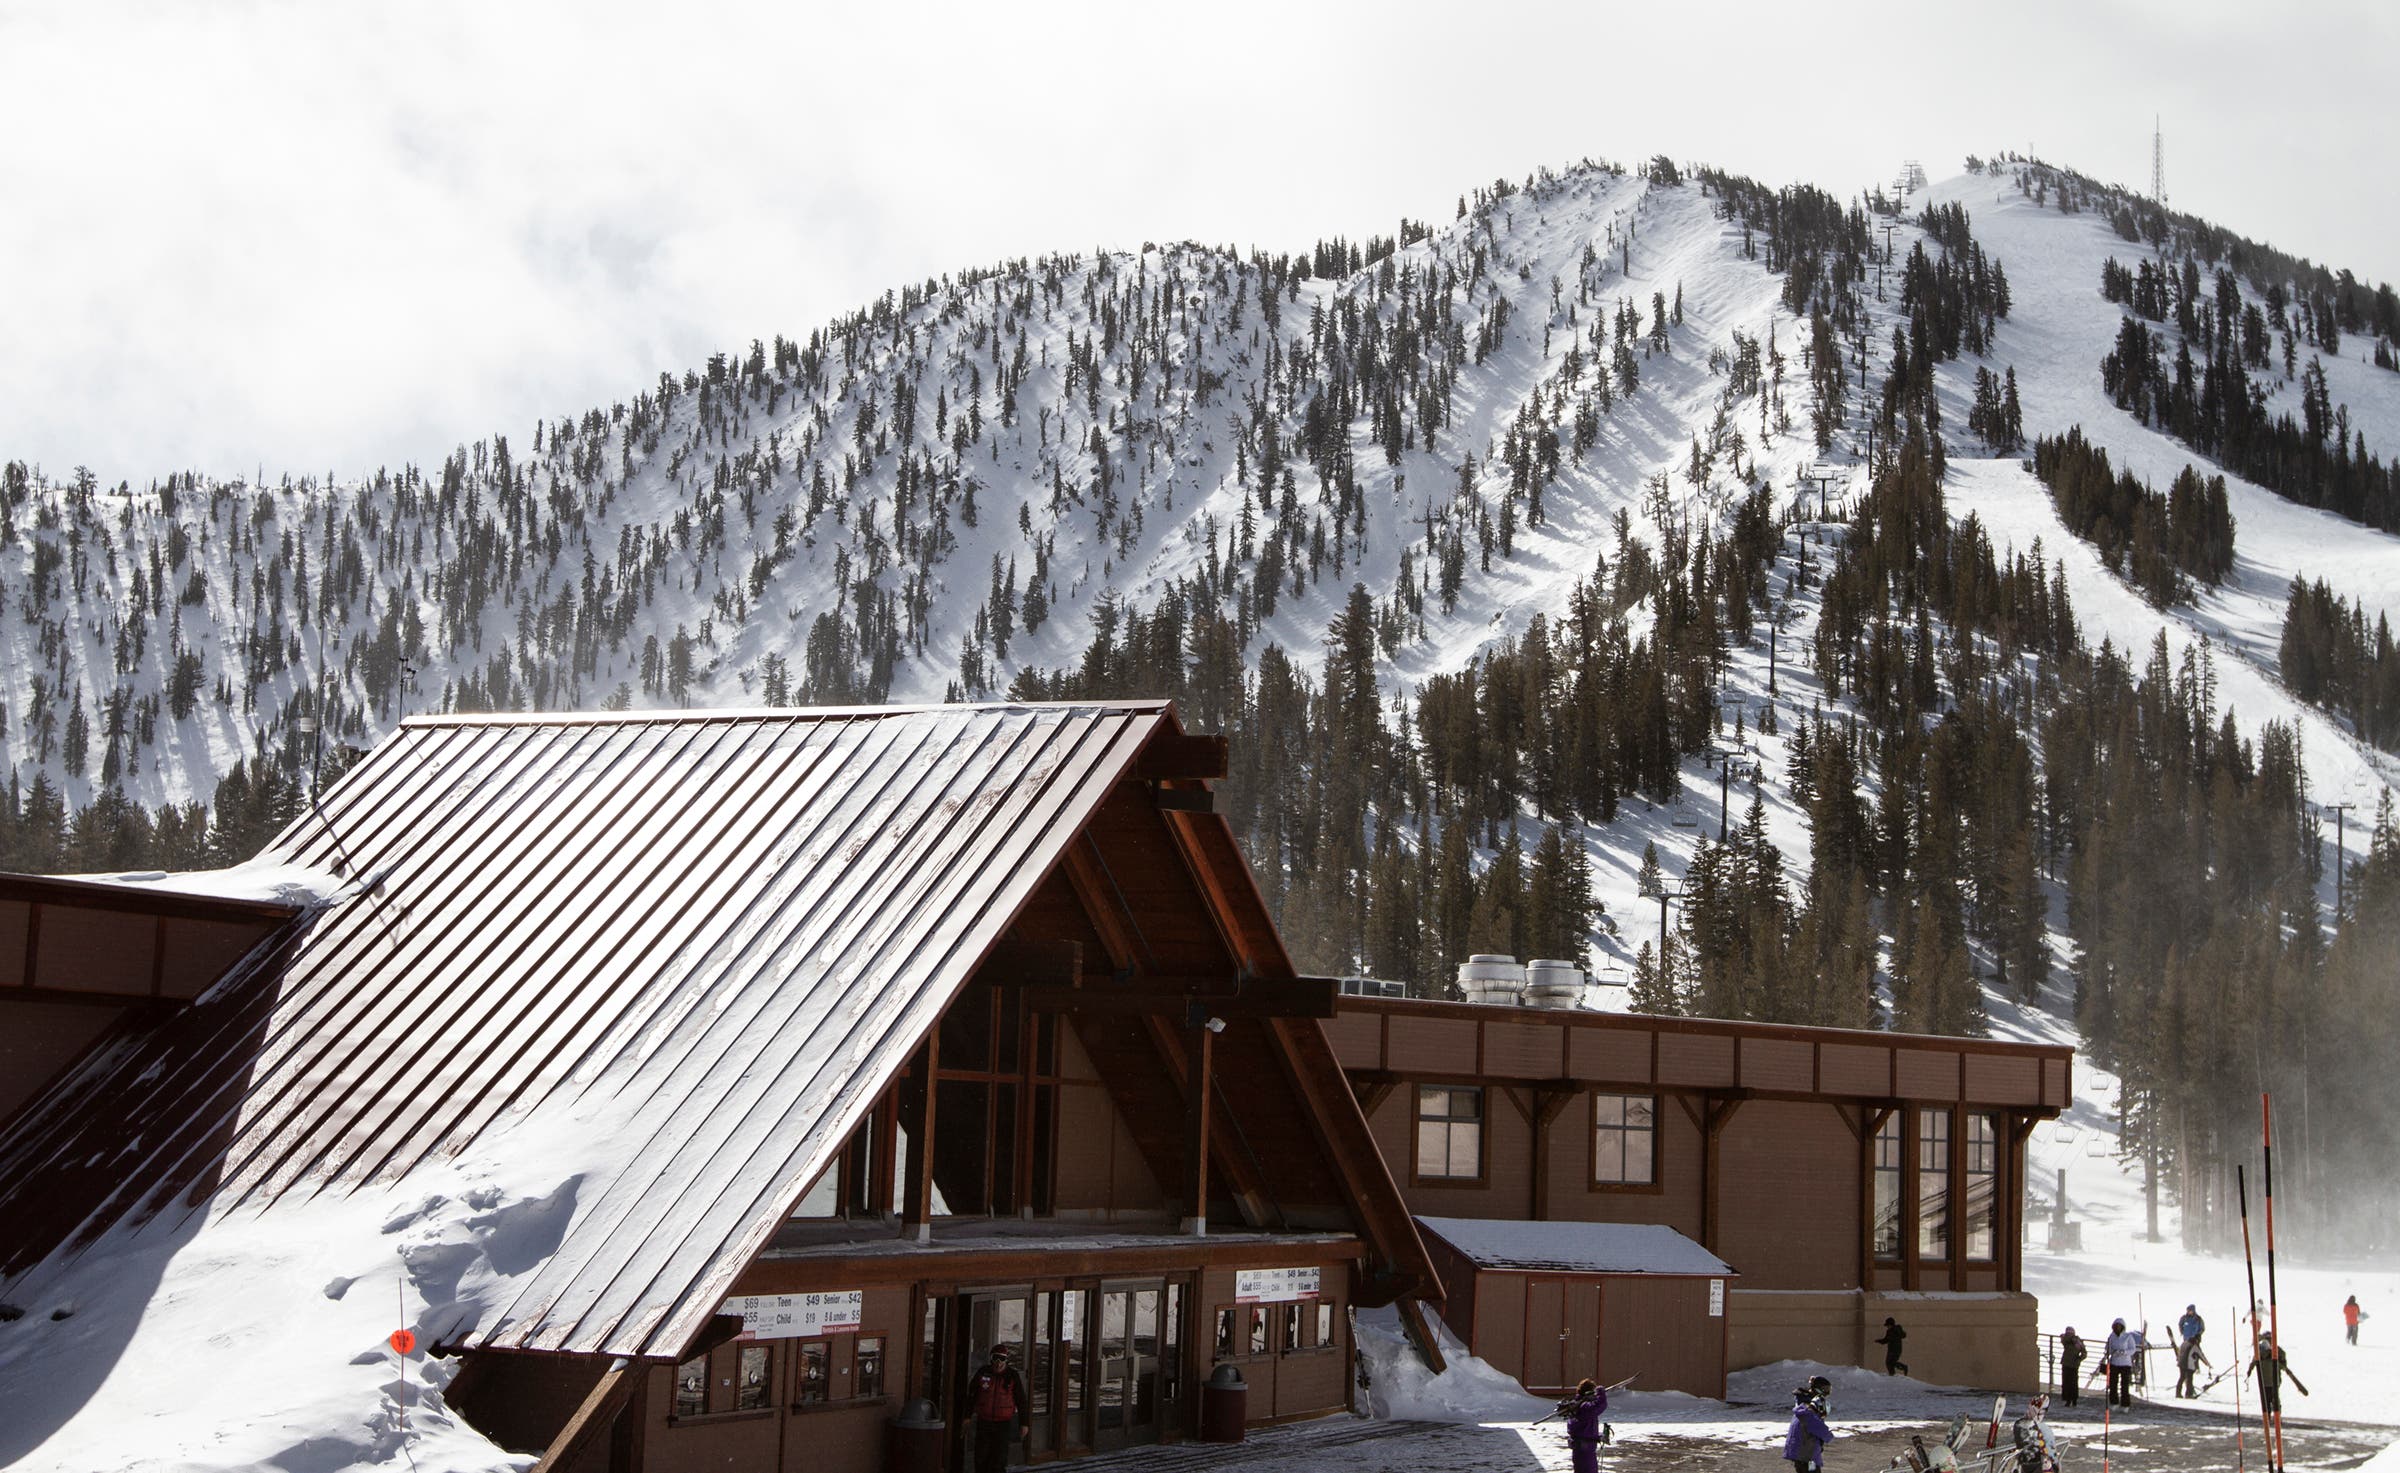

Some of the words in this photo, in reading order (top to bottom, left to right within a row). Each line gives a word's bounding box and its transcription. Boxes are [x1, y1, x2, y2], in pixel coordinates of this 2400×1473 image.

[744, 1297, 760, 1310] $69
[777, 1296, 792, 1308] Teen
[806, 1294, 820, 1307] $49
[823, 1293, 841, 1306] Senior
[848, 1292, 862, 1305] $42
[743, 1311, 759, 1324] $55
[776, 1313, 792, 1325] Child
[805, 1312, 816, 1325] $19
[833, 1311, 848, 1322] under
[851, 1309, 861, 1322] $5
